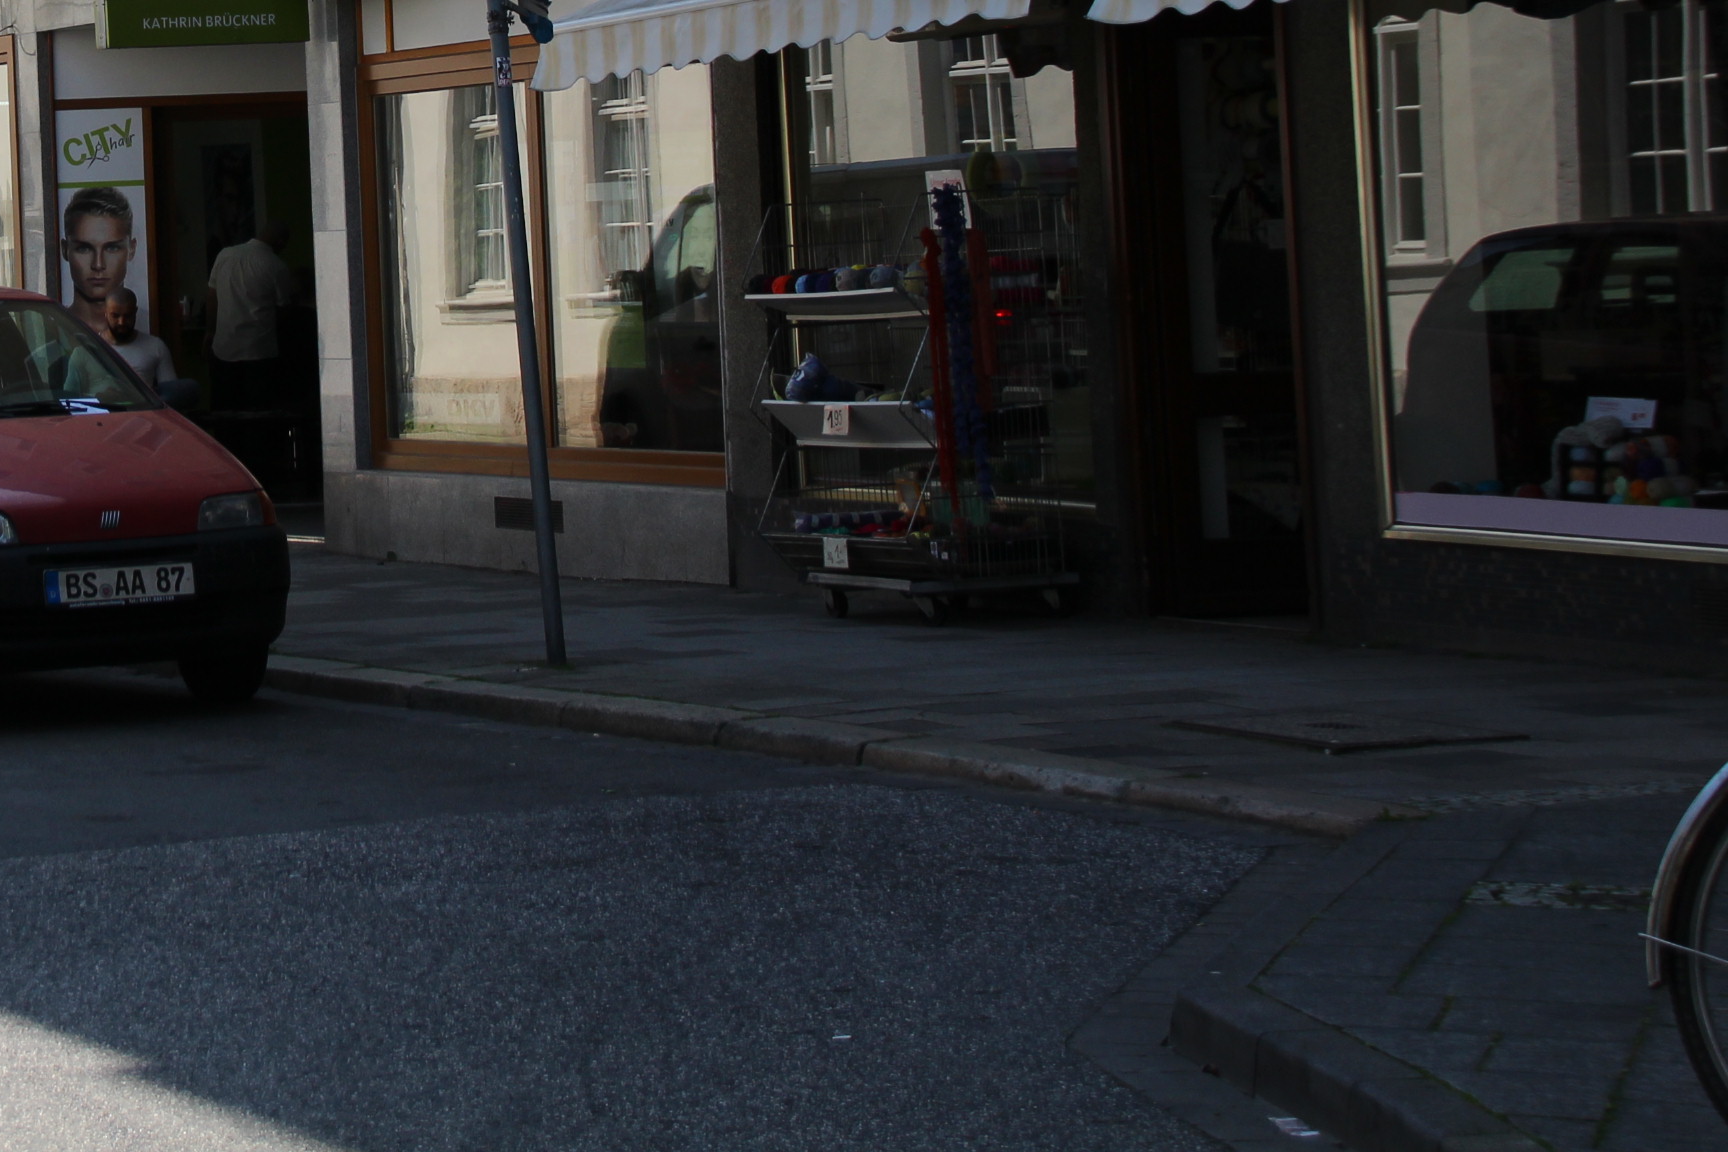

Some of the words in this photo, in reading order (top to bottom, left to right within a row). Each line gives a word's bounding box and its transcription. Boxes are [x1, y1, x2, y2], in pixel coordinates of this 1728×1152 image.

[142, 15, 202, 30] KATHRIN
[205, 12, 276, 29] BRÜCKNER
[63, 117, 132, 166] CITY
[109, 134, 135, 150] hair
[65, 572, 98, 599] BS
[115, 569, 147, 596] AA
[156, 566, 186, 593] 87
